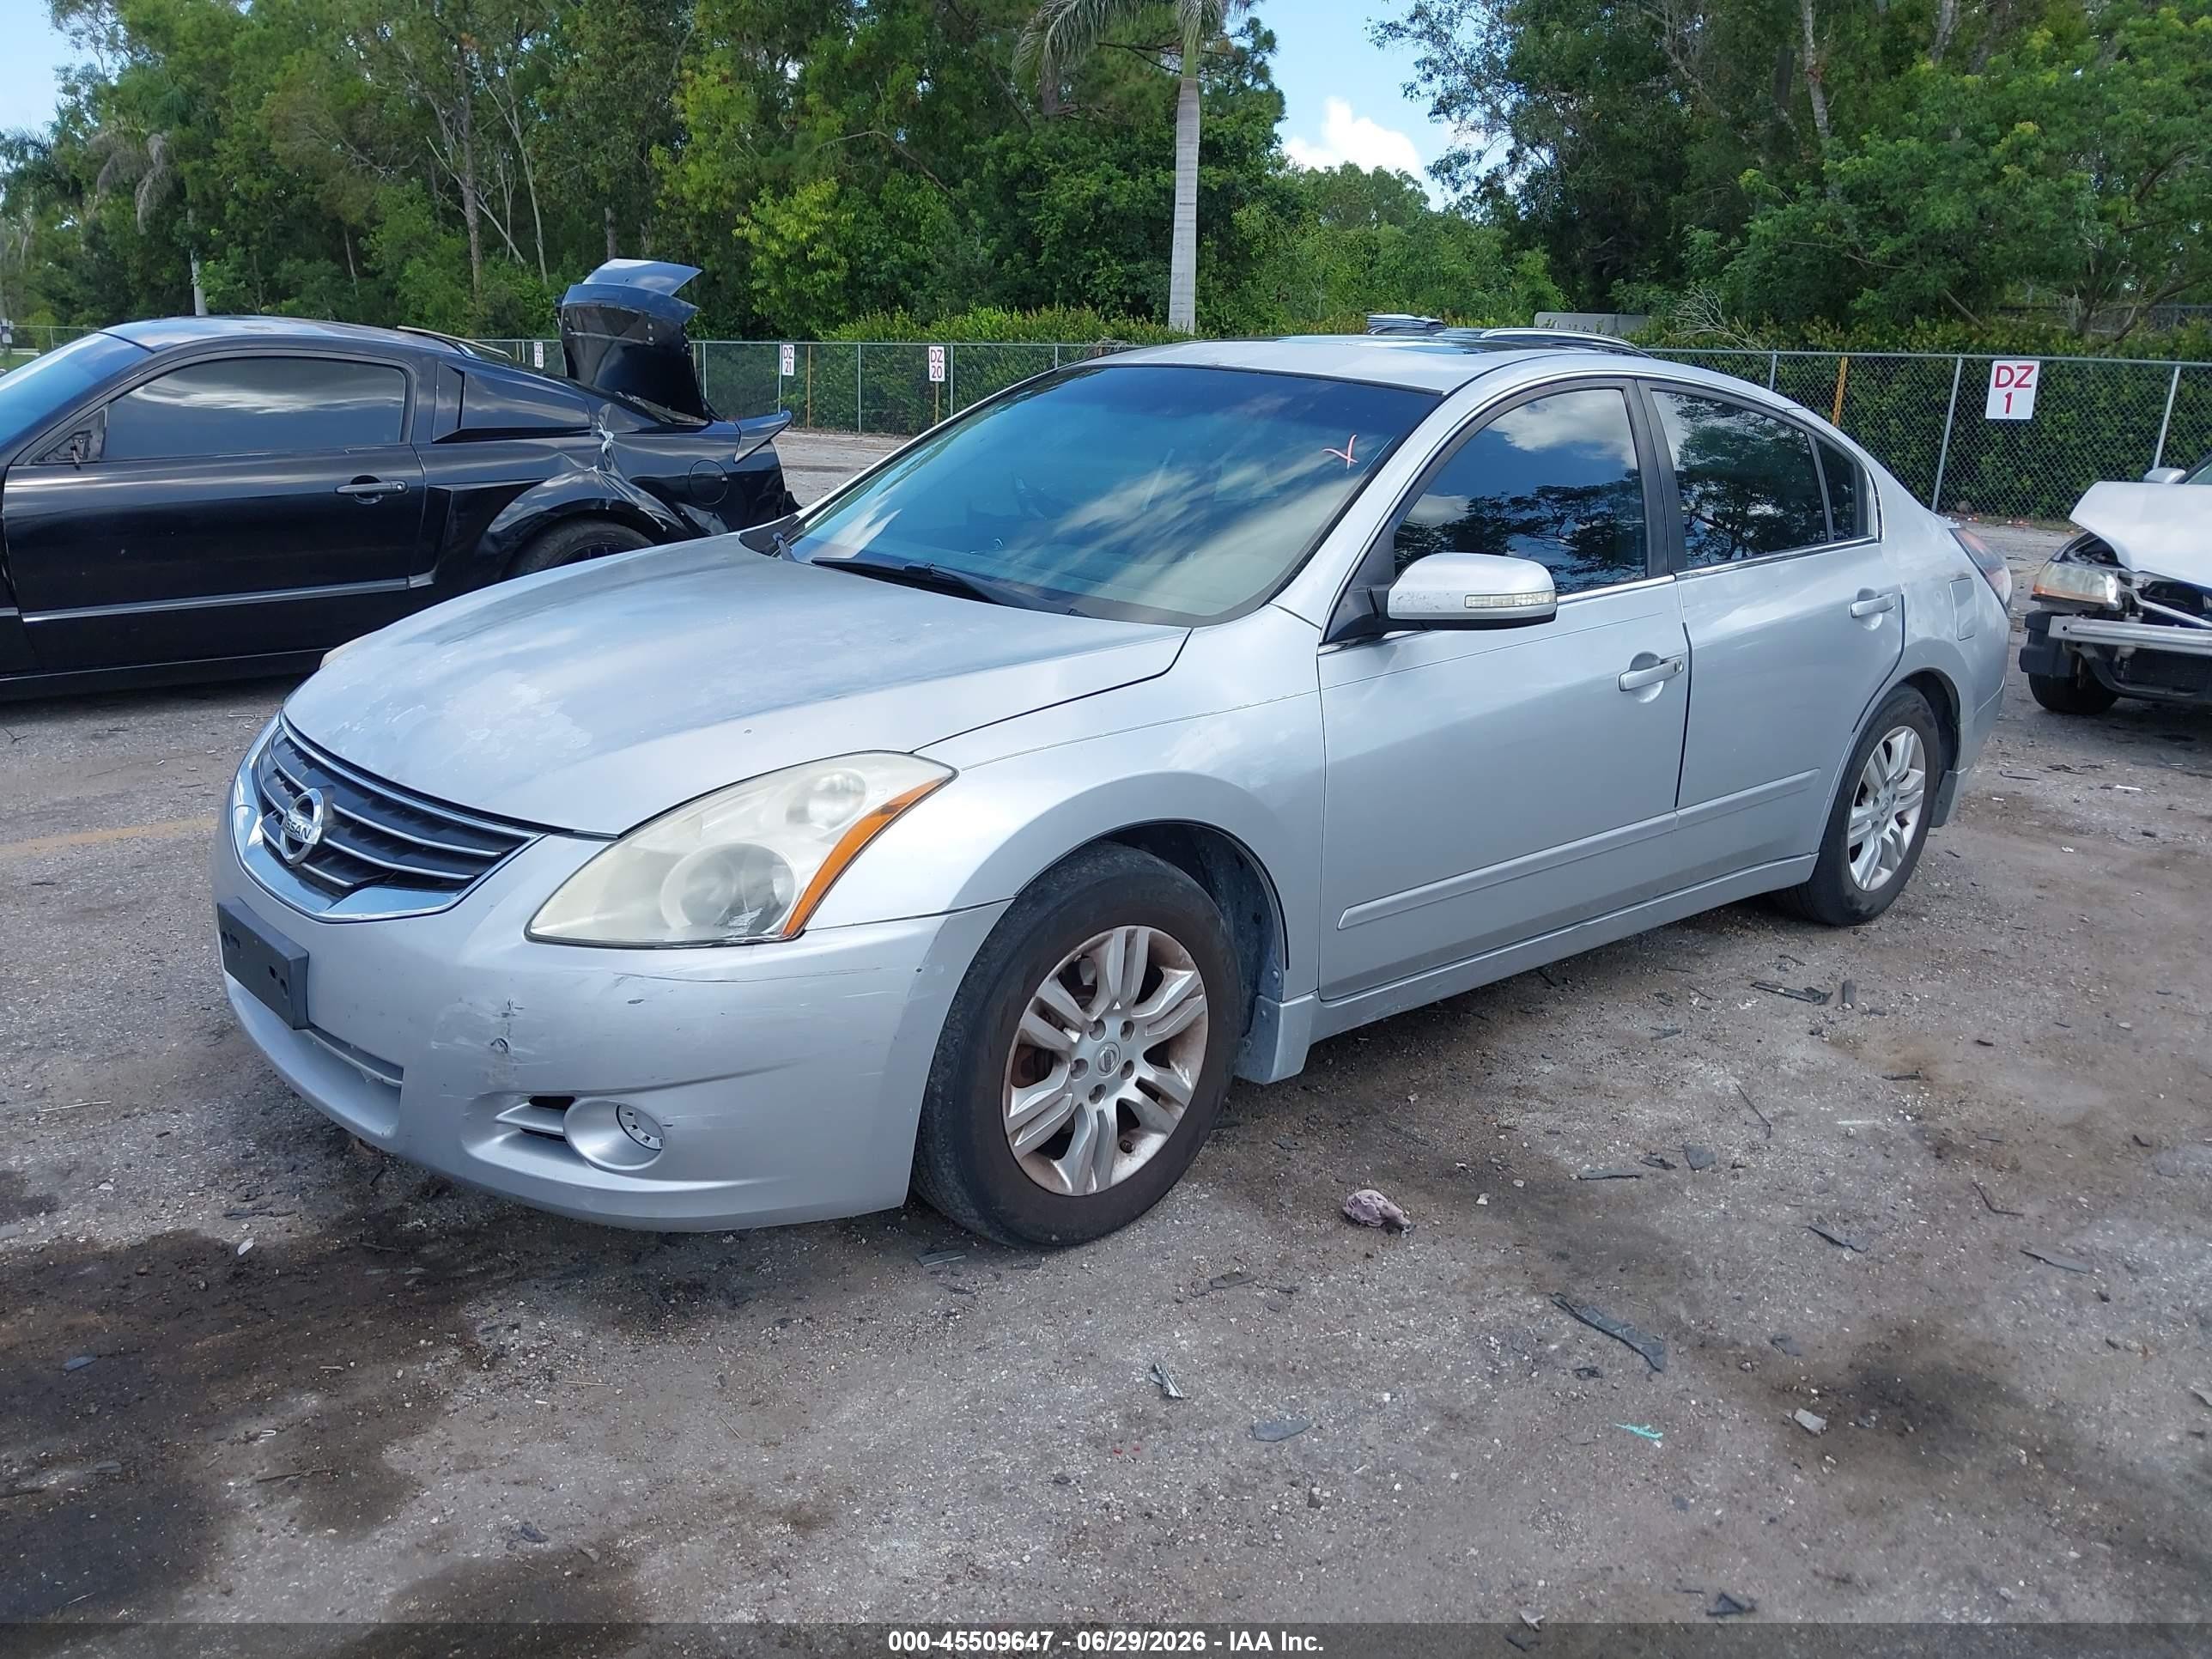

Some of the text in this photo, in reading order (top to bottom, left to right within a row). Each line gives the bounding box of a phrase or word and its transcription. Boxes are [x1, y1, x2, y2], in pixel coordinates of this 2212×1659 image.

[535, 343, 542, 354] DZ
[783, 347, 793, 359] DZ
[931, 349, 943, 362] DZ
[785, 361, 791, 373] 21
[931, 365, 942, 378] 20
[1994, 365, 2034, 388] DZ
[2004, 392, 2013, 414] 1
[283, 818, 312, 840] SSAN
